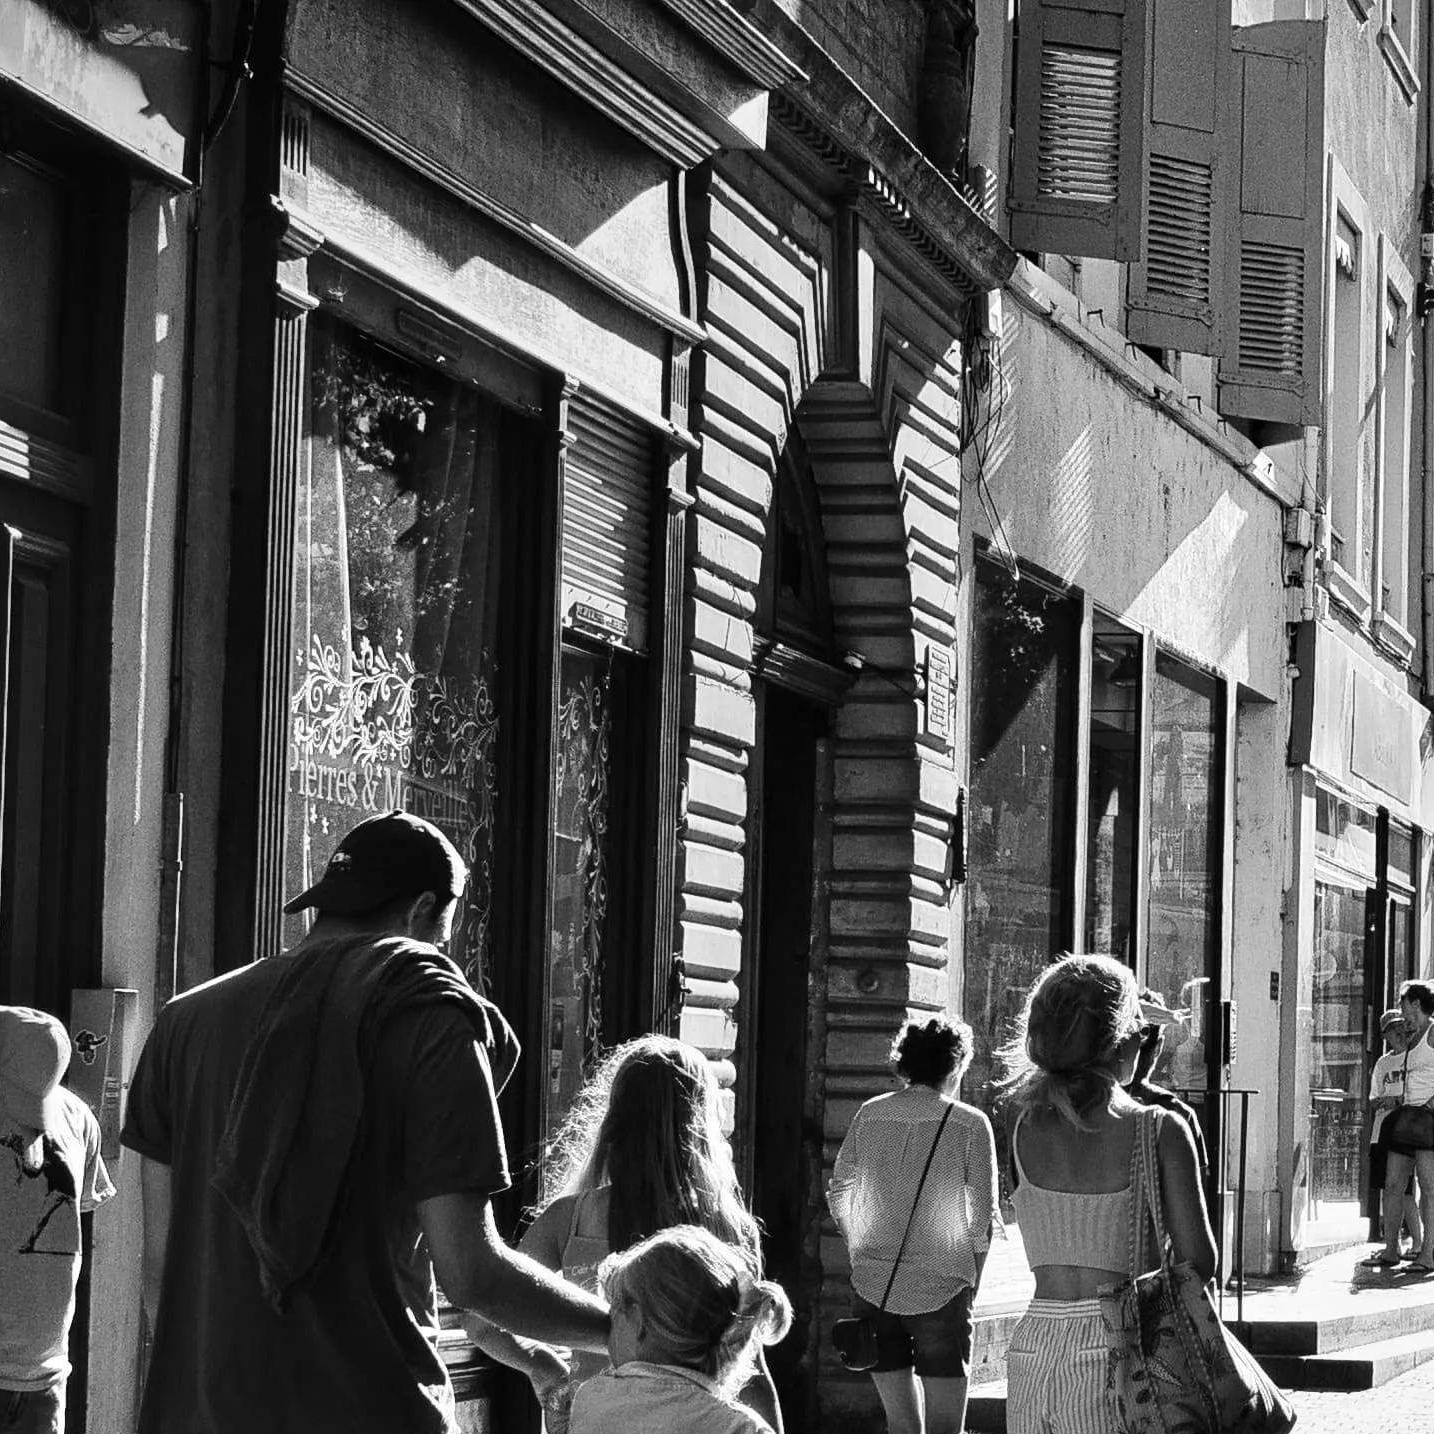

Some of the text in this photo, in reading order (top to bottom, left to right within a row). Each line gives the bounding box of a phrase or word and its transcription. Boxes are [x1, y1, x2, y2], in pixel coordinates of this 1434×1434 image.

[288, 743, 478, 830] Pierres & Merveilles
